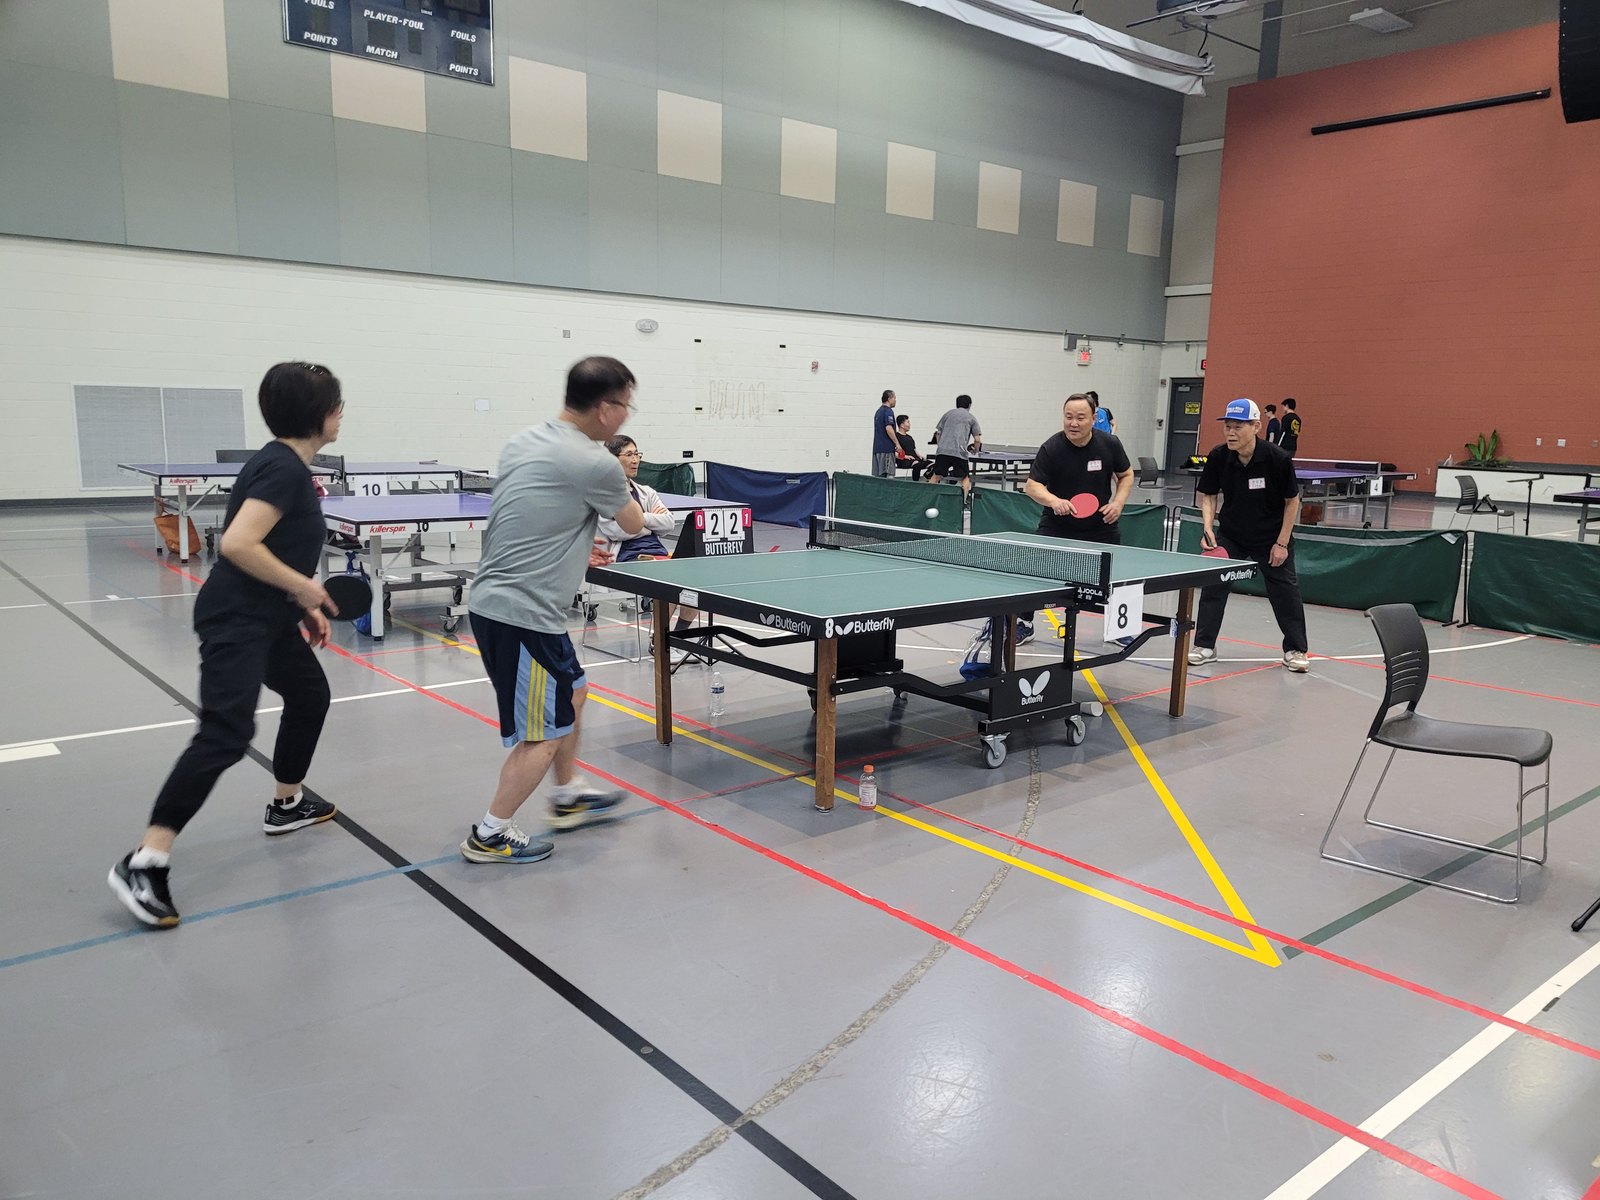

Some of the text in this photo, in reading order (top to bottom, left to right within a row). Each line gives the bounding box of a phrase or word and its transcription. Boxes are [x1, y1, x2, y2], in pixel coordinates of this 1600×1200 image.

[363, 9, 425, 31] PLAYER-FOUL
[304, 31, 338, 46] POINTS
[450, 30, 477, 43] FOULS
[365, 45, 398, 59] MATCH
[449, 63, 479, 76] POINTS
[362, 484, 381, 496] 10
[369, 521, 429, 534] killerspin 10
[710, 513, 719, 535] 2
[730, 512, 738, 535] 2
[744, 513, 749, 525] 1
[705, 541, 743, 555] BUTTERFLY
[1230, 569, 1254, 580] Butterfly
[1082, 587, 1103, 597] JOOLA
[1117, 603, 1128, 630] 8
[775, 615, 812, 636] Butterfly
[825, 618, 834, 639] 8
[854, 617, 895, 634] Butterfly
[1021, 694, 1044, 706] Butterfly
